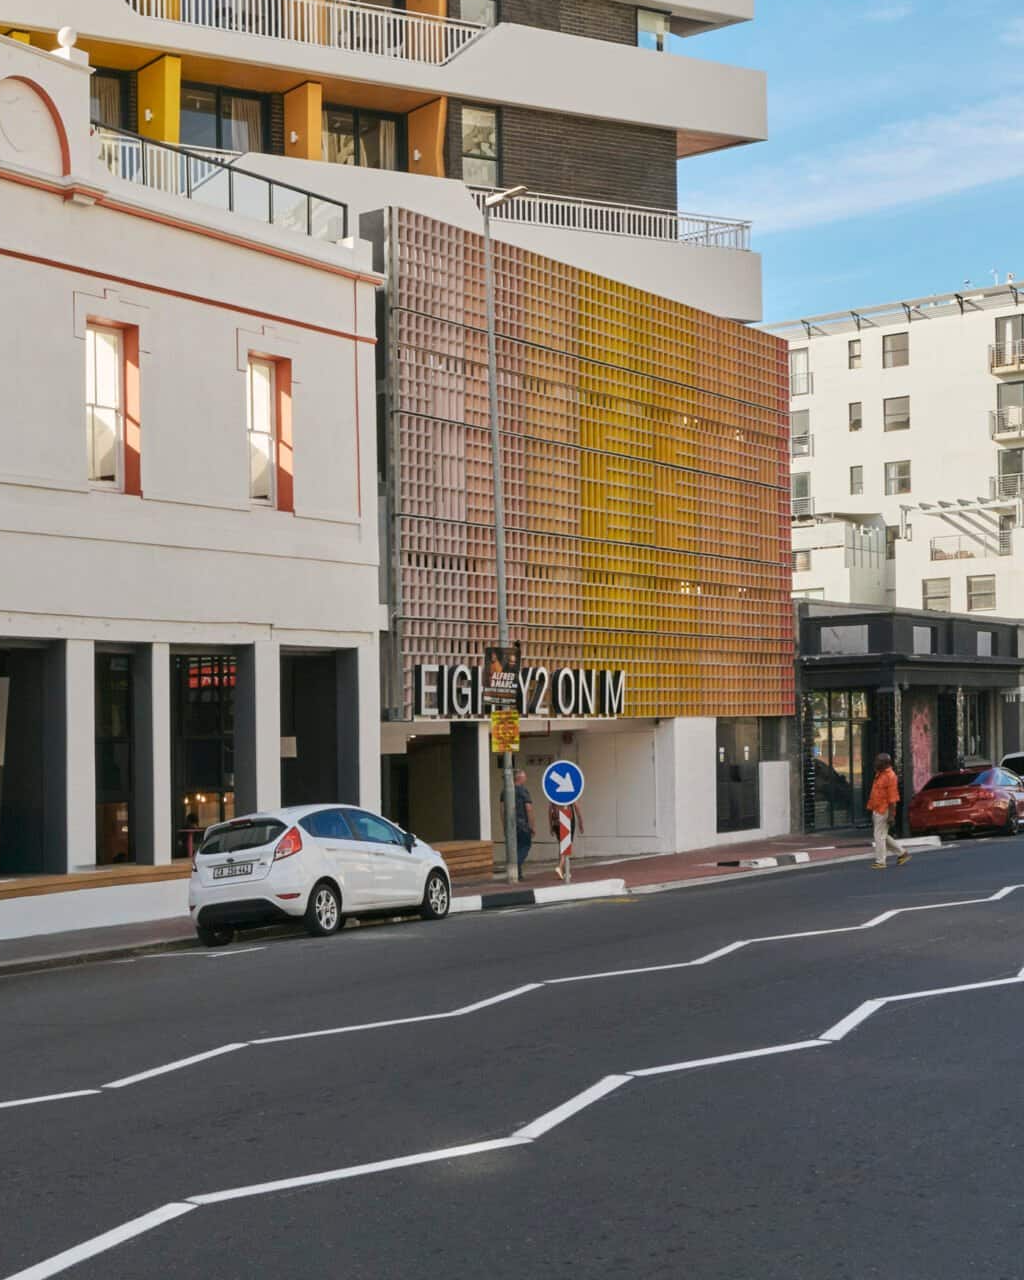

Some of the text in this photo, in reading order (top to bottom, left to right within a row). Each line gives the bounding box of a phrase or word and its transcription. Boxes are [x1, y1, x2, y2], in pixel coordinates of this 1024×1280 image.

[419, 664, 625, 715] EIGHY2 ON M
